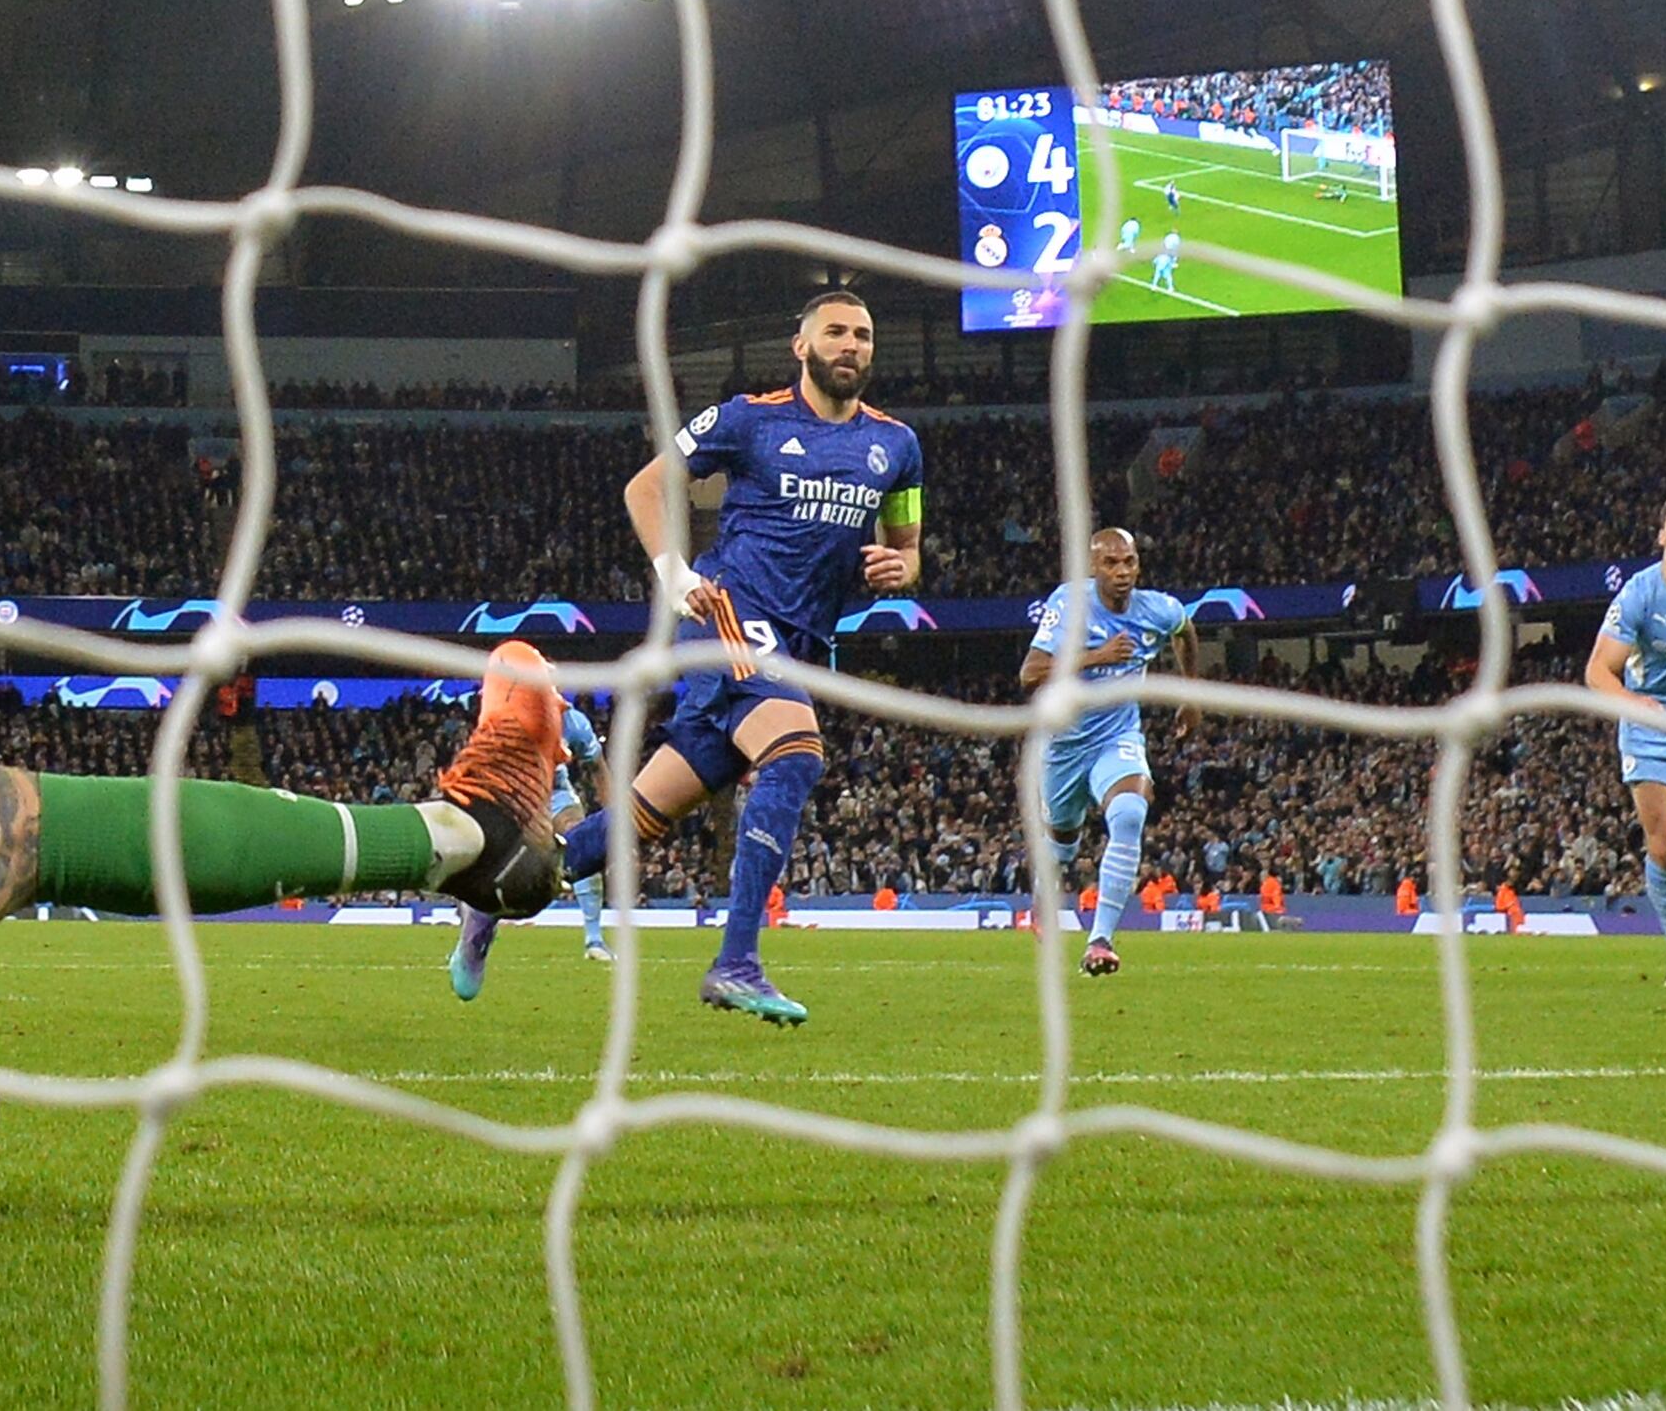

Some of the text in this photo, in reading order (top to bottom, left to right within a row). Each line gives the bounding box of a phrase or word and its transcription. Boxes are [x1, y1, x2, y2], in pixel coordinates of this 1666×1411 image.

[976, 92, 1052, 121] 81:23
[1026, 133, 1075, 194] 4
[1032, 211, 1075, 273] 2
[780, 473, 884, 509] Emirates
[742, 620, 778, 658] 9
